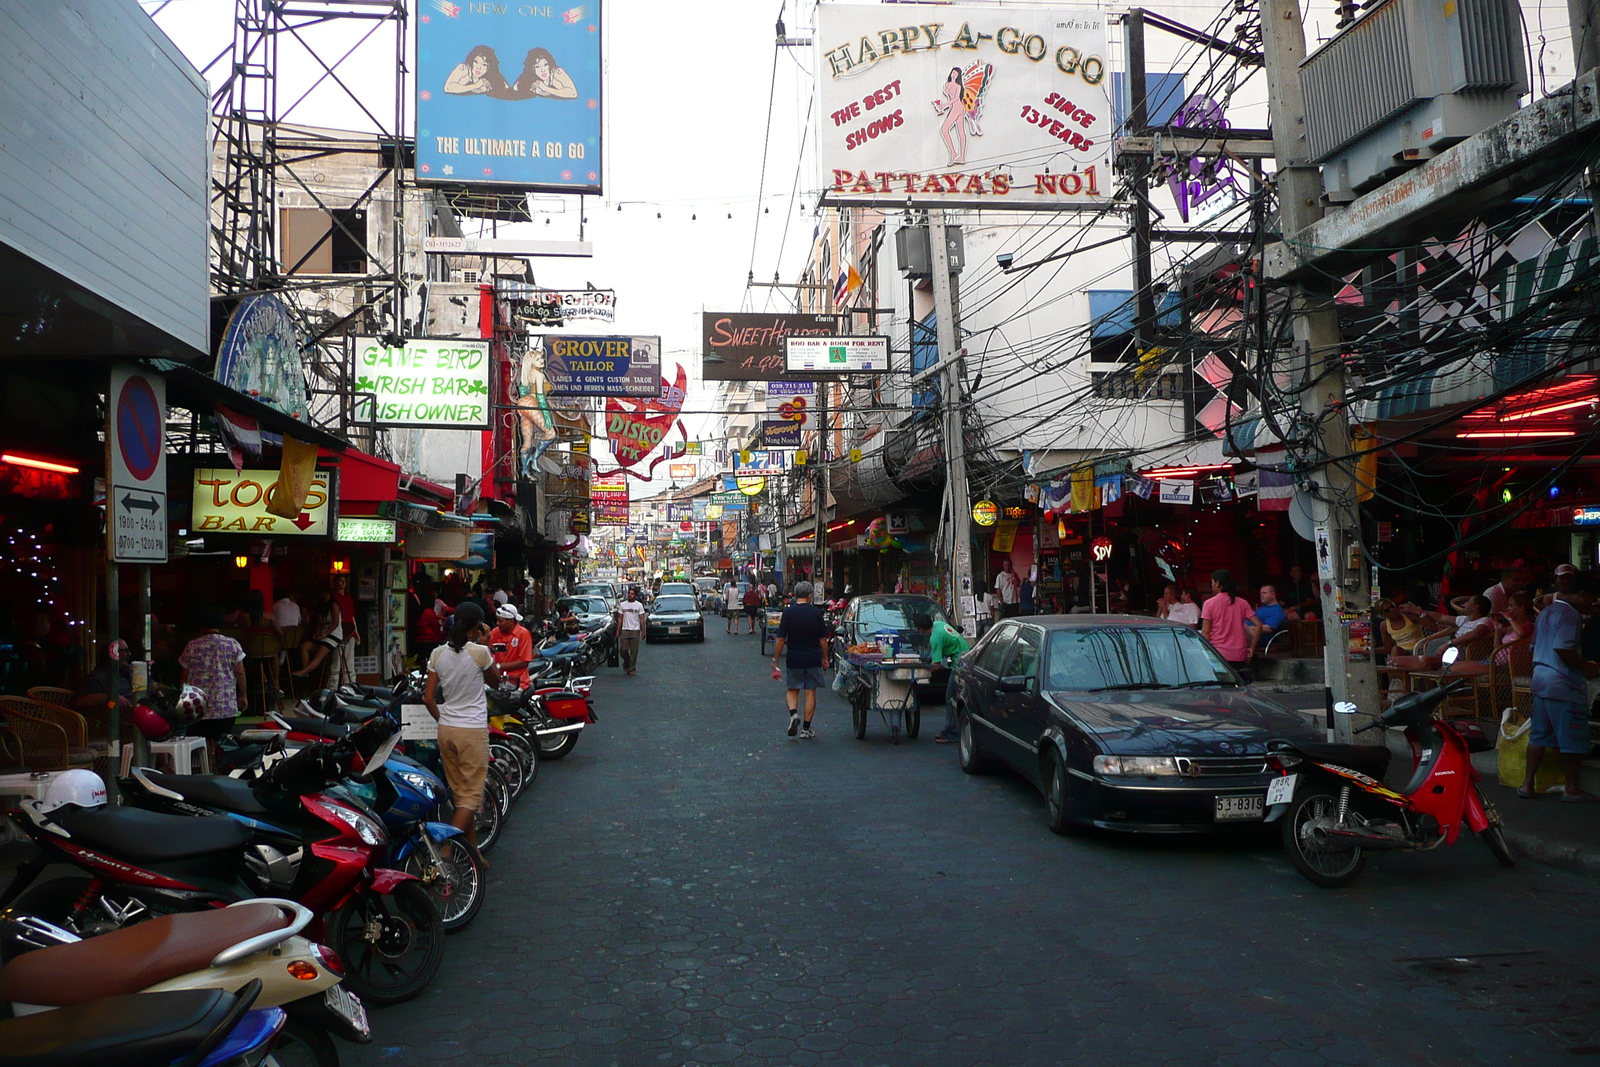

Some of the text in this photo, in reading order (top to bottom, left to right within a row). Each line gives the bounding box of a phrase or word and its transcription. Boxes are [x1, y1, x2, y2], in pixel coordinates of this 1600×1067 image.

[468, 2, 555, 17] NEW ONE
[824, 23, 944, 79] HAPPY
[1055, 45, 1105, 85] GO
[831, 79, 902, 127] THE BEST
[1044, 92, 1096, 129] SINCE
[845, 109, 904, 150] SHOWS
[436, 136, 585, 160] THE ULTIMATE A GO GO
[832, 169, 1010, 196] PATTAYA'S
[552, 340, 629, 357] GROVER
[363, 346, 483, 370] GAME BIRD
[569, 361, 614, 372] TAILOR
[740, 356, 755, 370] A
[373, 374, 469, 396] IRISH BAR
[552, 375, 573, 383] LADIES
[634, 376, 652, 384] TAILOR
[607, 385, 655, 393] MASS-SCHNEIDER
[415, 403, 482, 421] OWNER
[609, 414, 662, 444] DISKO
[621, 445, 641, 461] TK
[1004, 506, 1027, 518] Tiger
[199, 515, 277, 531] BAR
[1093, 544, 1113, 561] SPY
